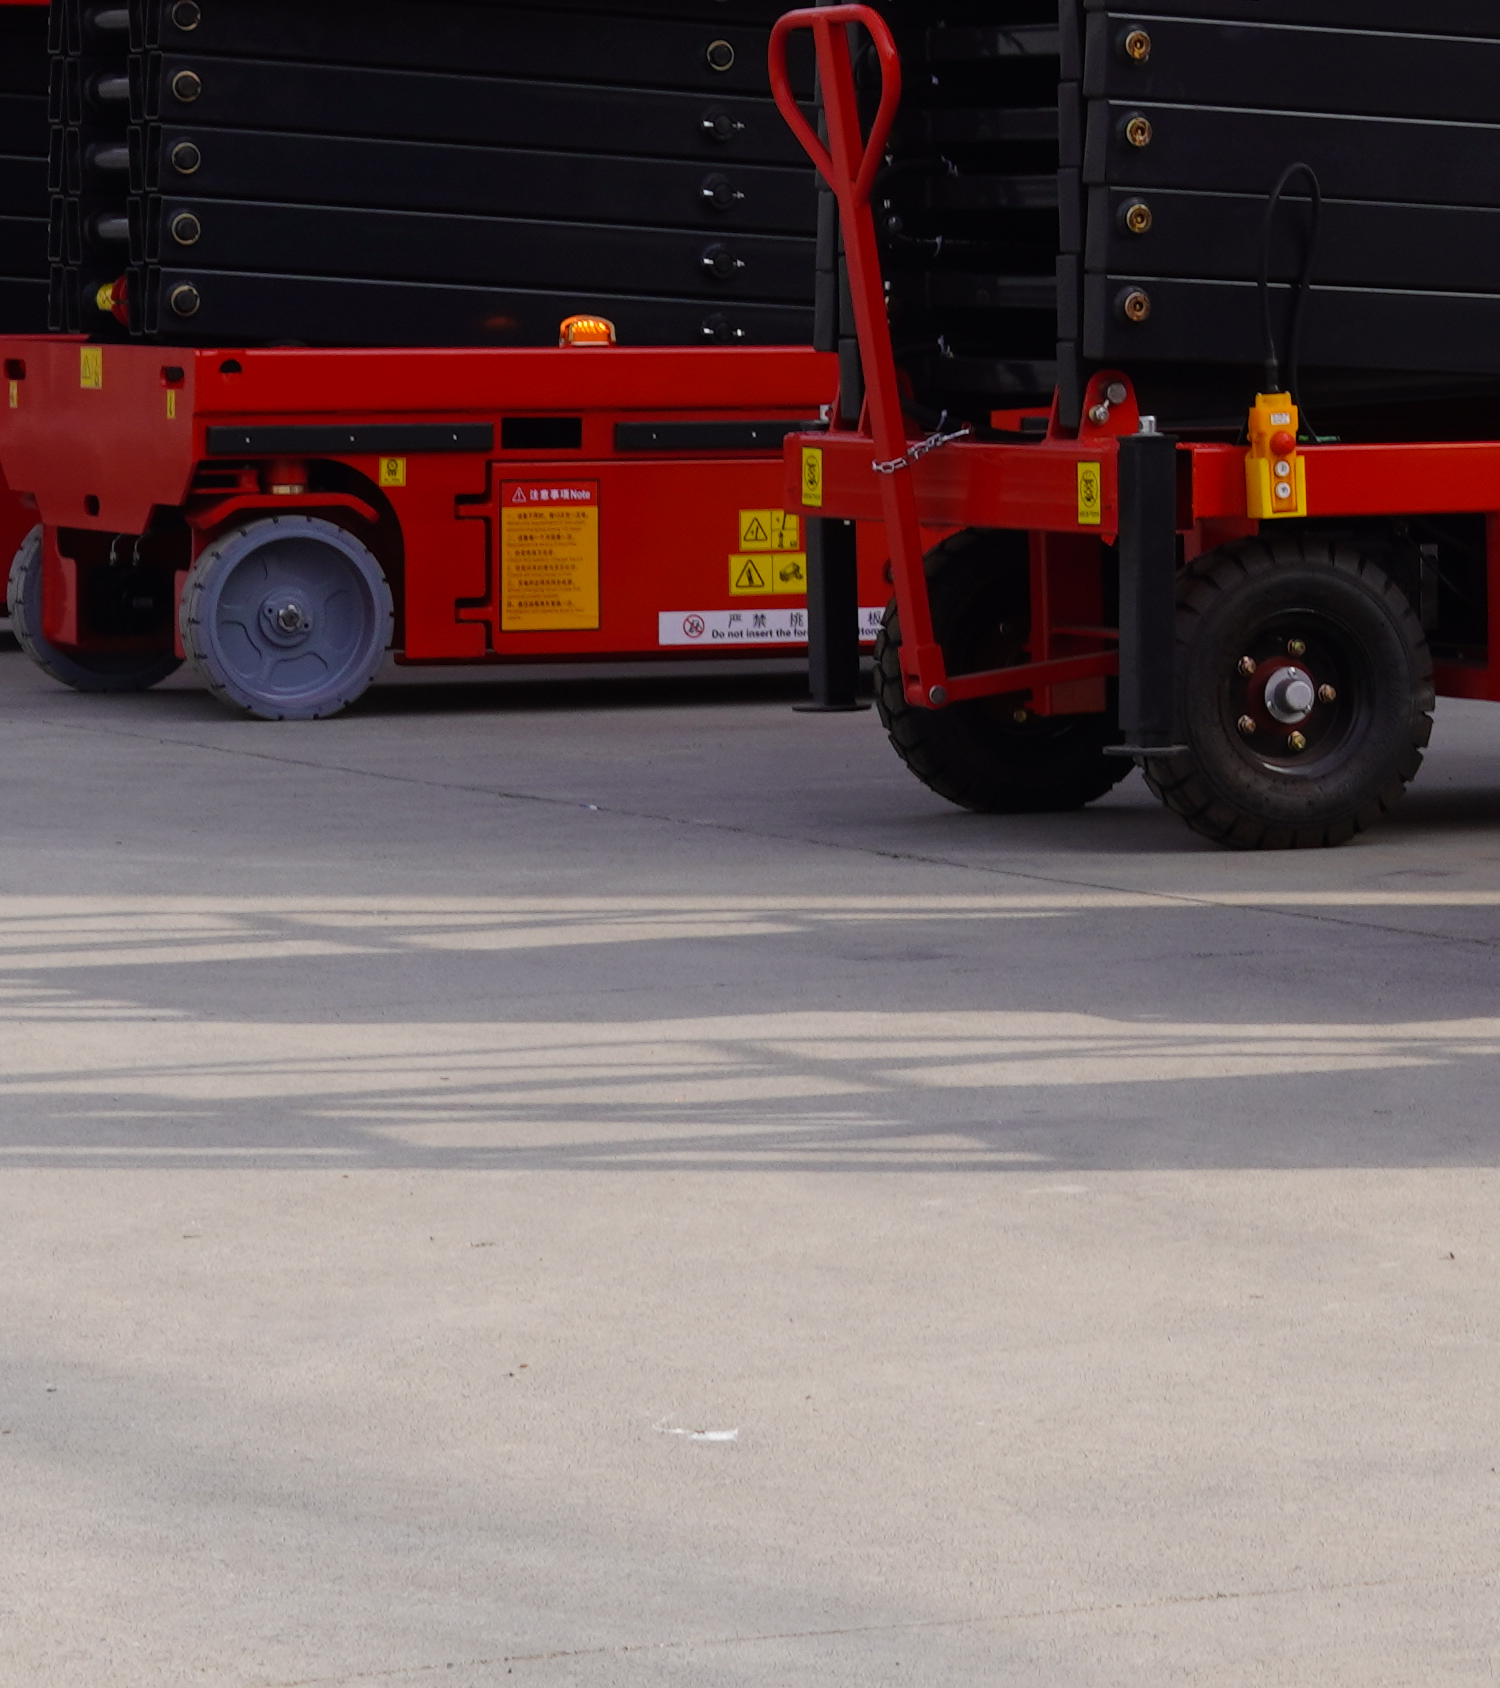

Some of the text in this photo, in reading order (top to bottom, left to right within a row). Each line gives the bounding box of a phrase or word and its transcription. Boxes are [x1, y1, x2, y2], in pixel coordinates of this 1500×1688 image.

[712, 628, 808, 639] Do not insert the for
